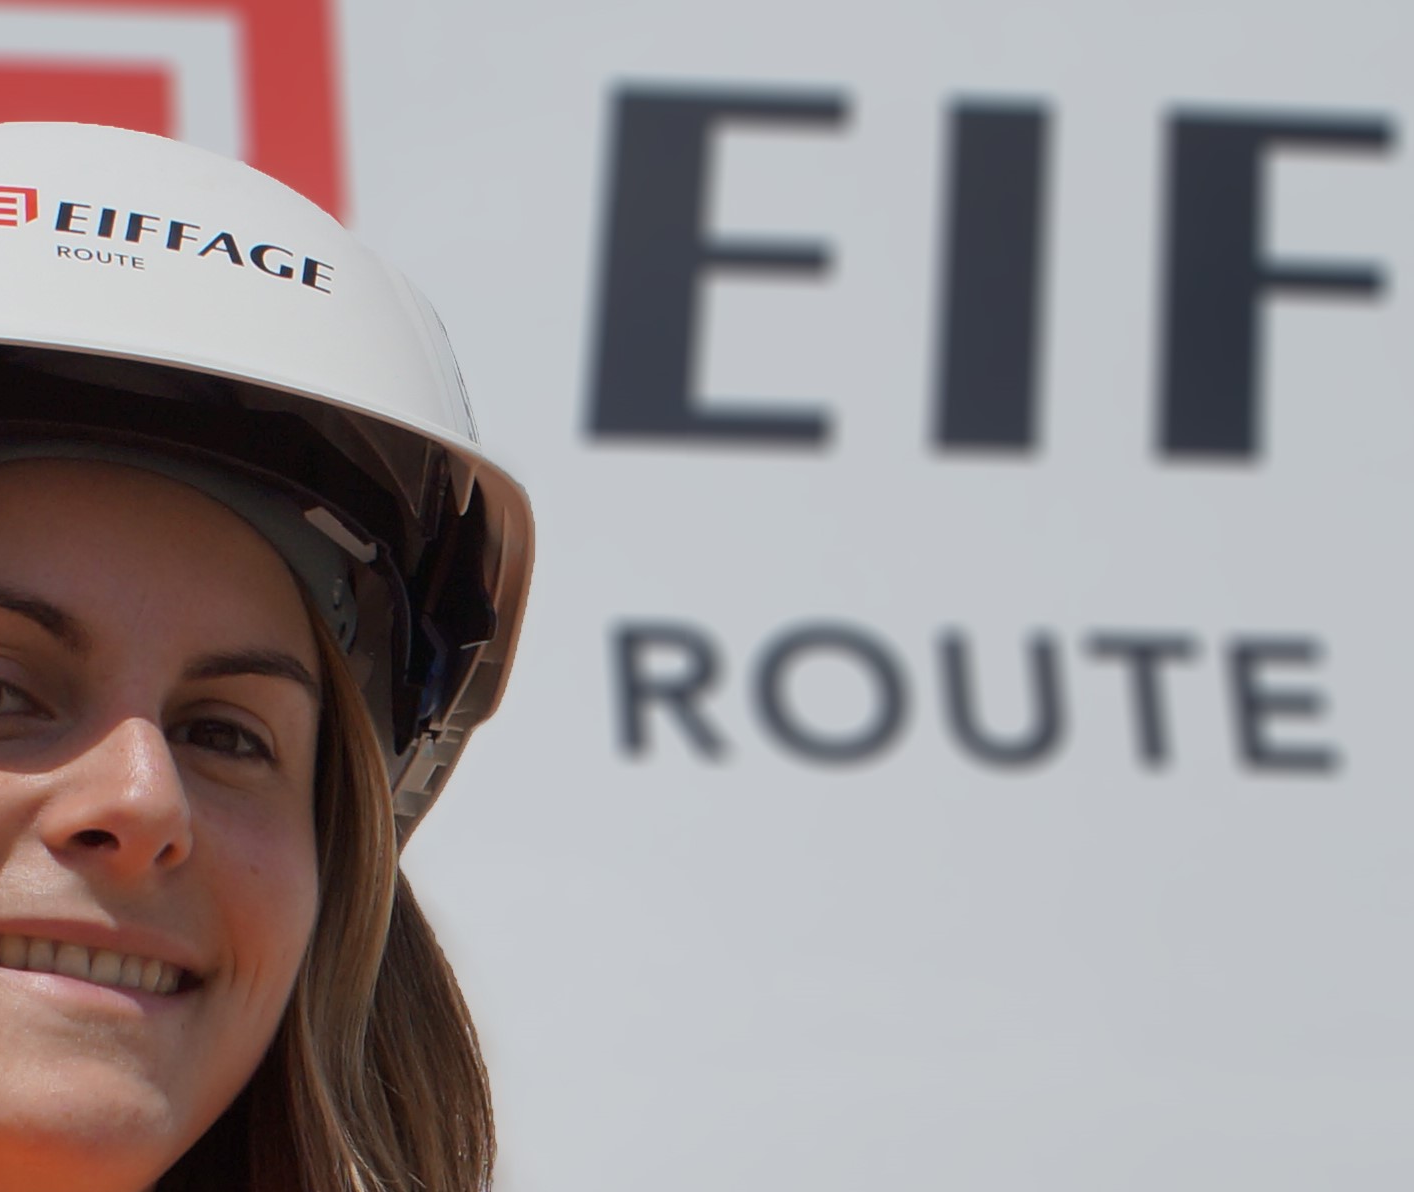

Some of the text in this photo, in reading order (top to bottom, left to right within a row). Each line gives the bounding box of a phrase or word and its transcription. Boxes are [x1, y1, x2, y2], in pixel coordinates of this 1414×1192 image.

[55, 201, 335, 294] EIFFAGE
[56, 245, 146, 270] ROUTE
[611, 622, 1339, 774] ROUTE
